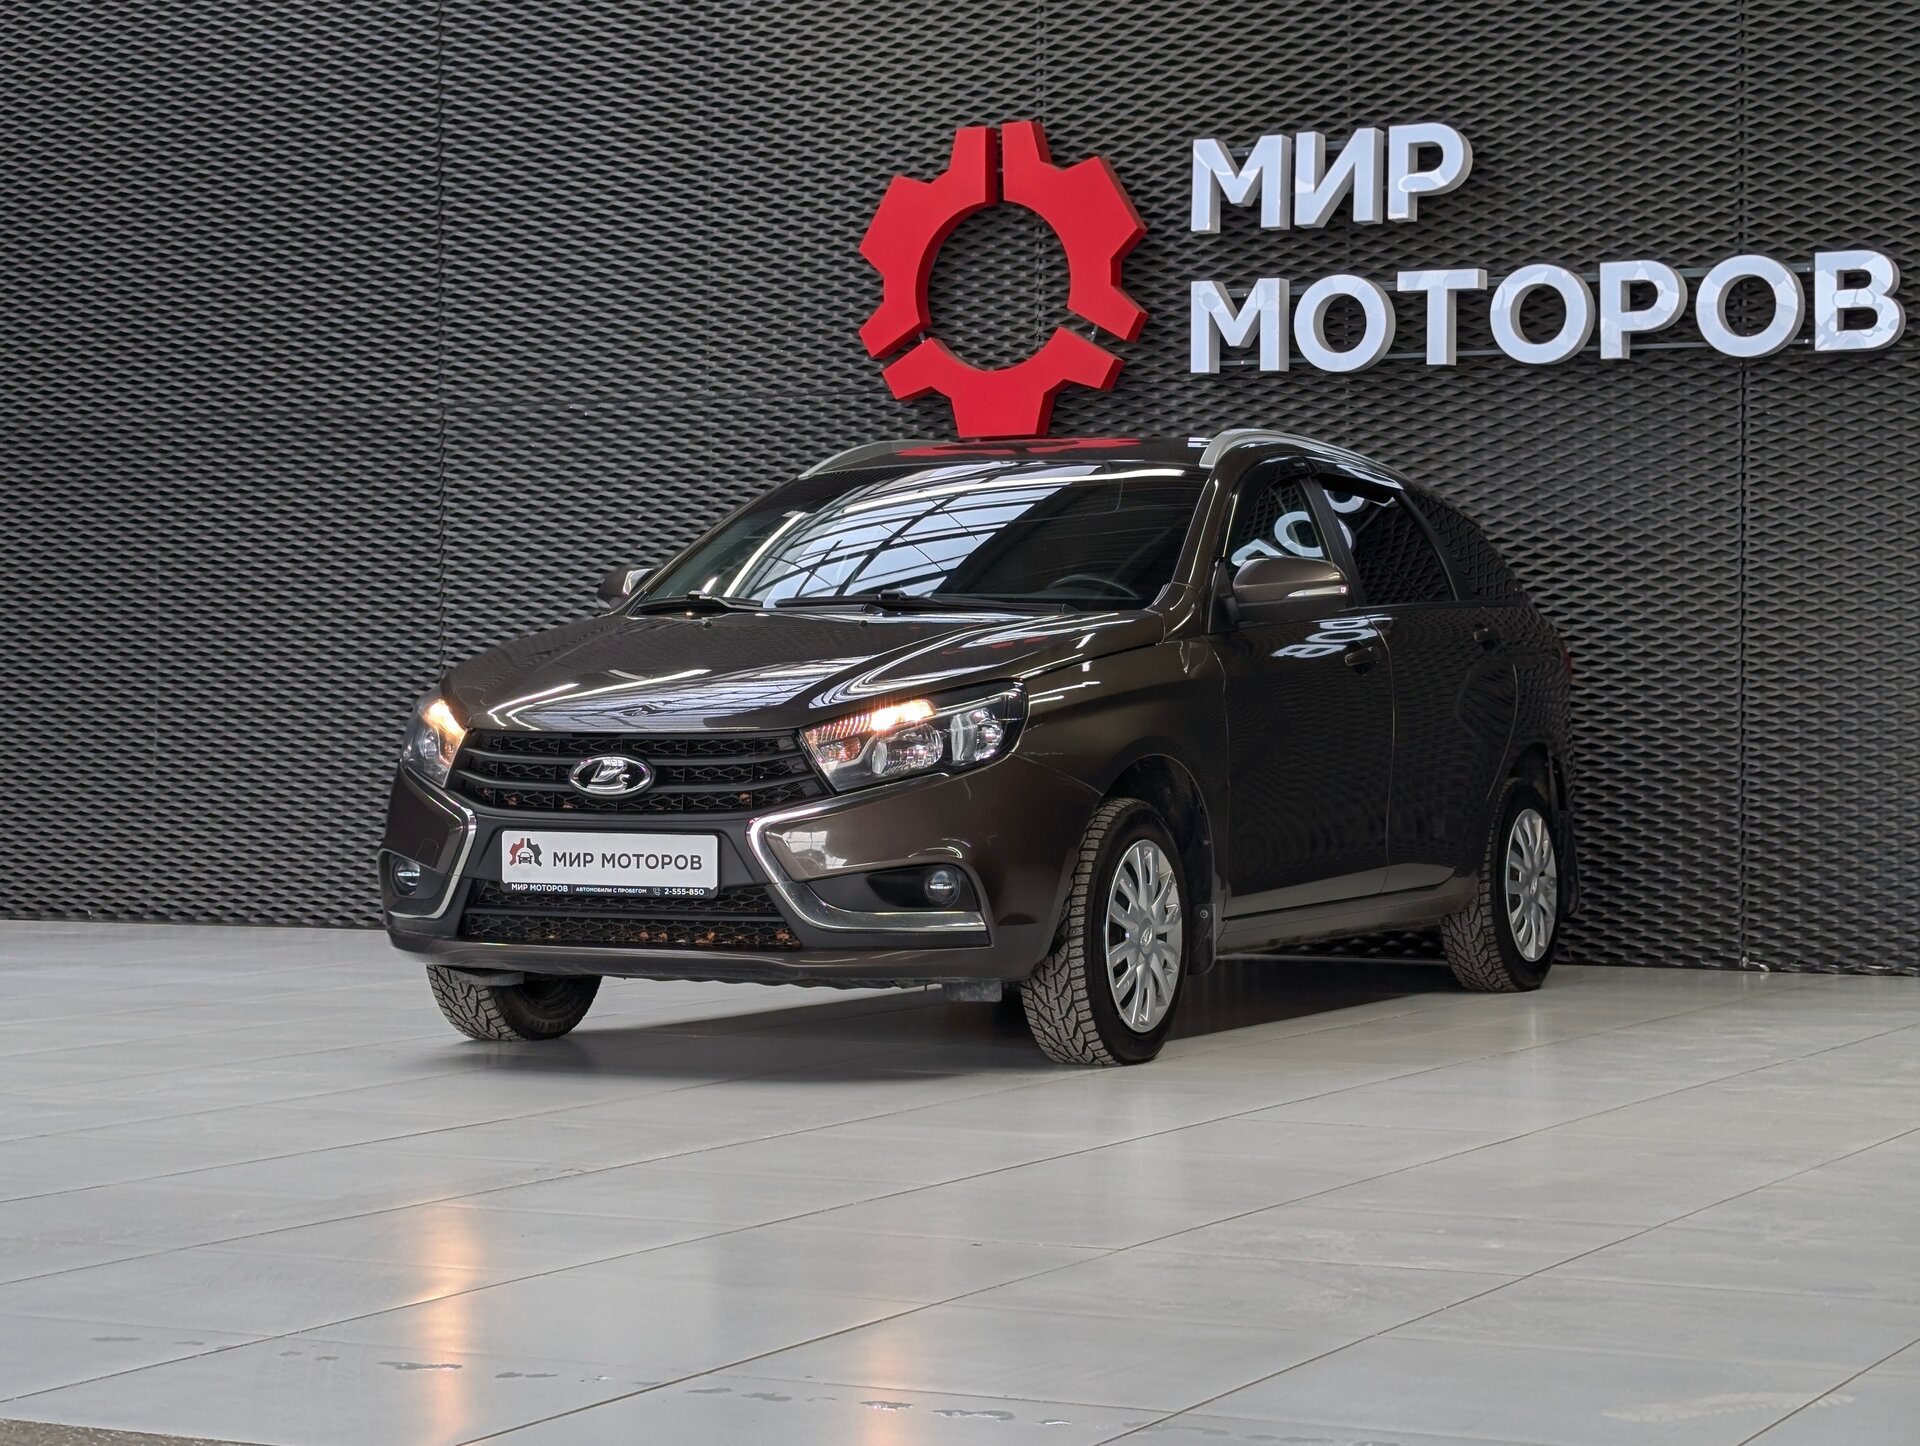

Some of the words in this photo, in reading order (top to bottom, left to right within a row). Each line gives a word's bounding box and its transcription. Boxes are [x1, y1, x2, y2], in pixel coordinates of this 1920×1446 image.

[1190, 121, 1473, 234] МИР
[1190, 250, 1906, 374] МОТОРОВ
[511, 883, 528, 891] МИР
[529, 884, 569, 893] МОТОРОВ
[664, 887, 705, 896] 2-555-850
[552, 851, 595, 868] МИР
[601, 853, 703, 871] МОТОРОВ
